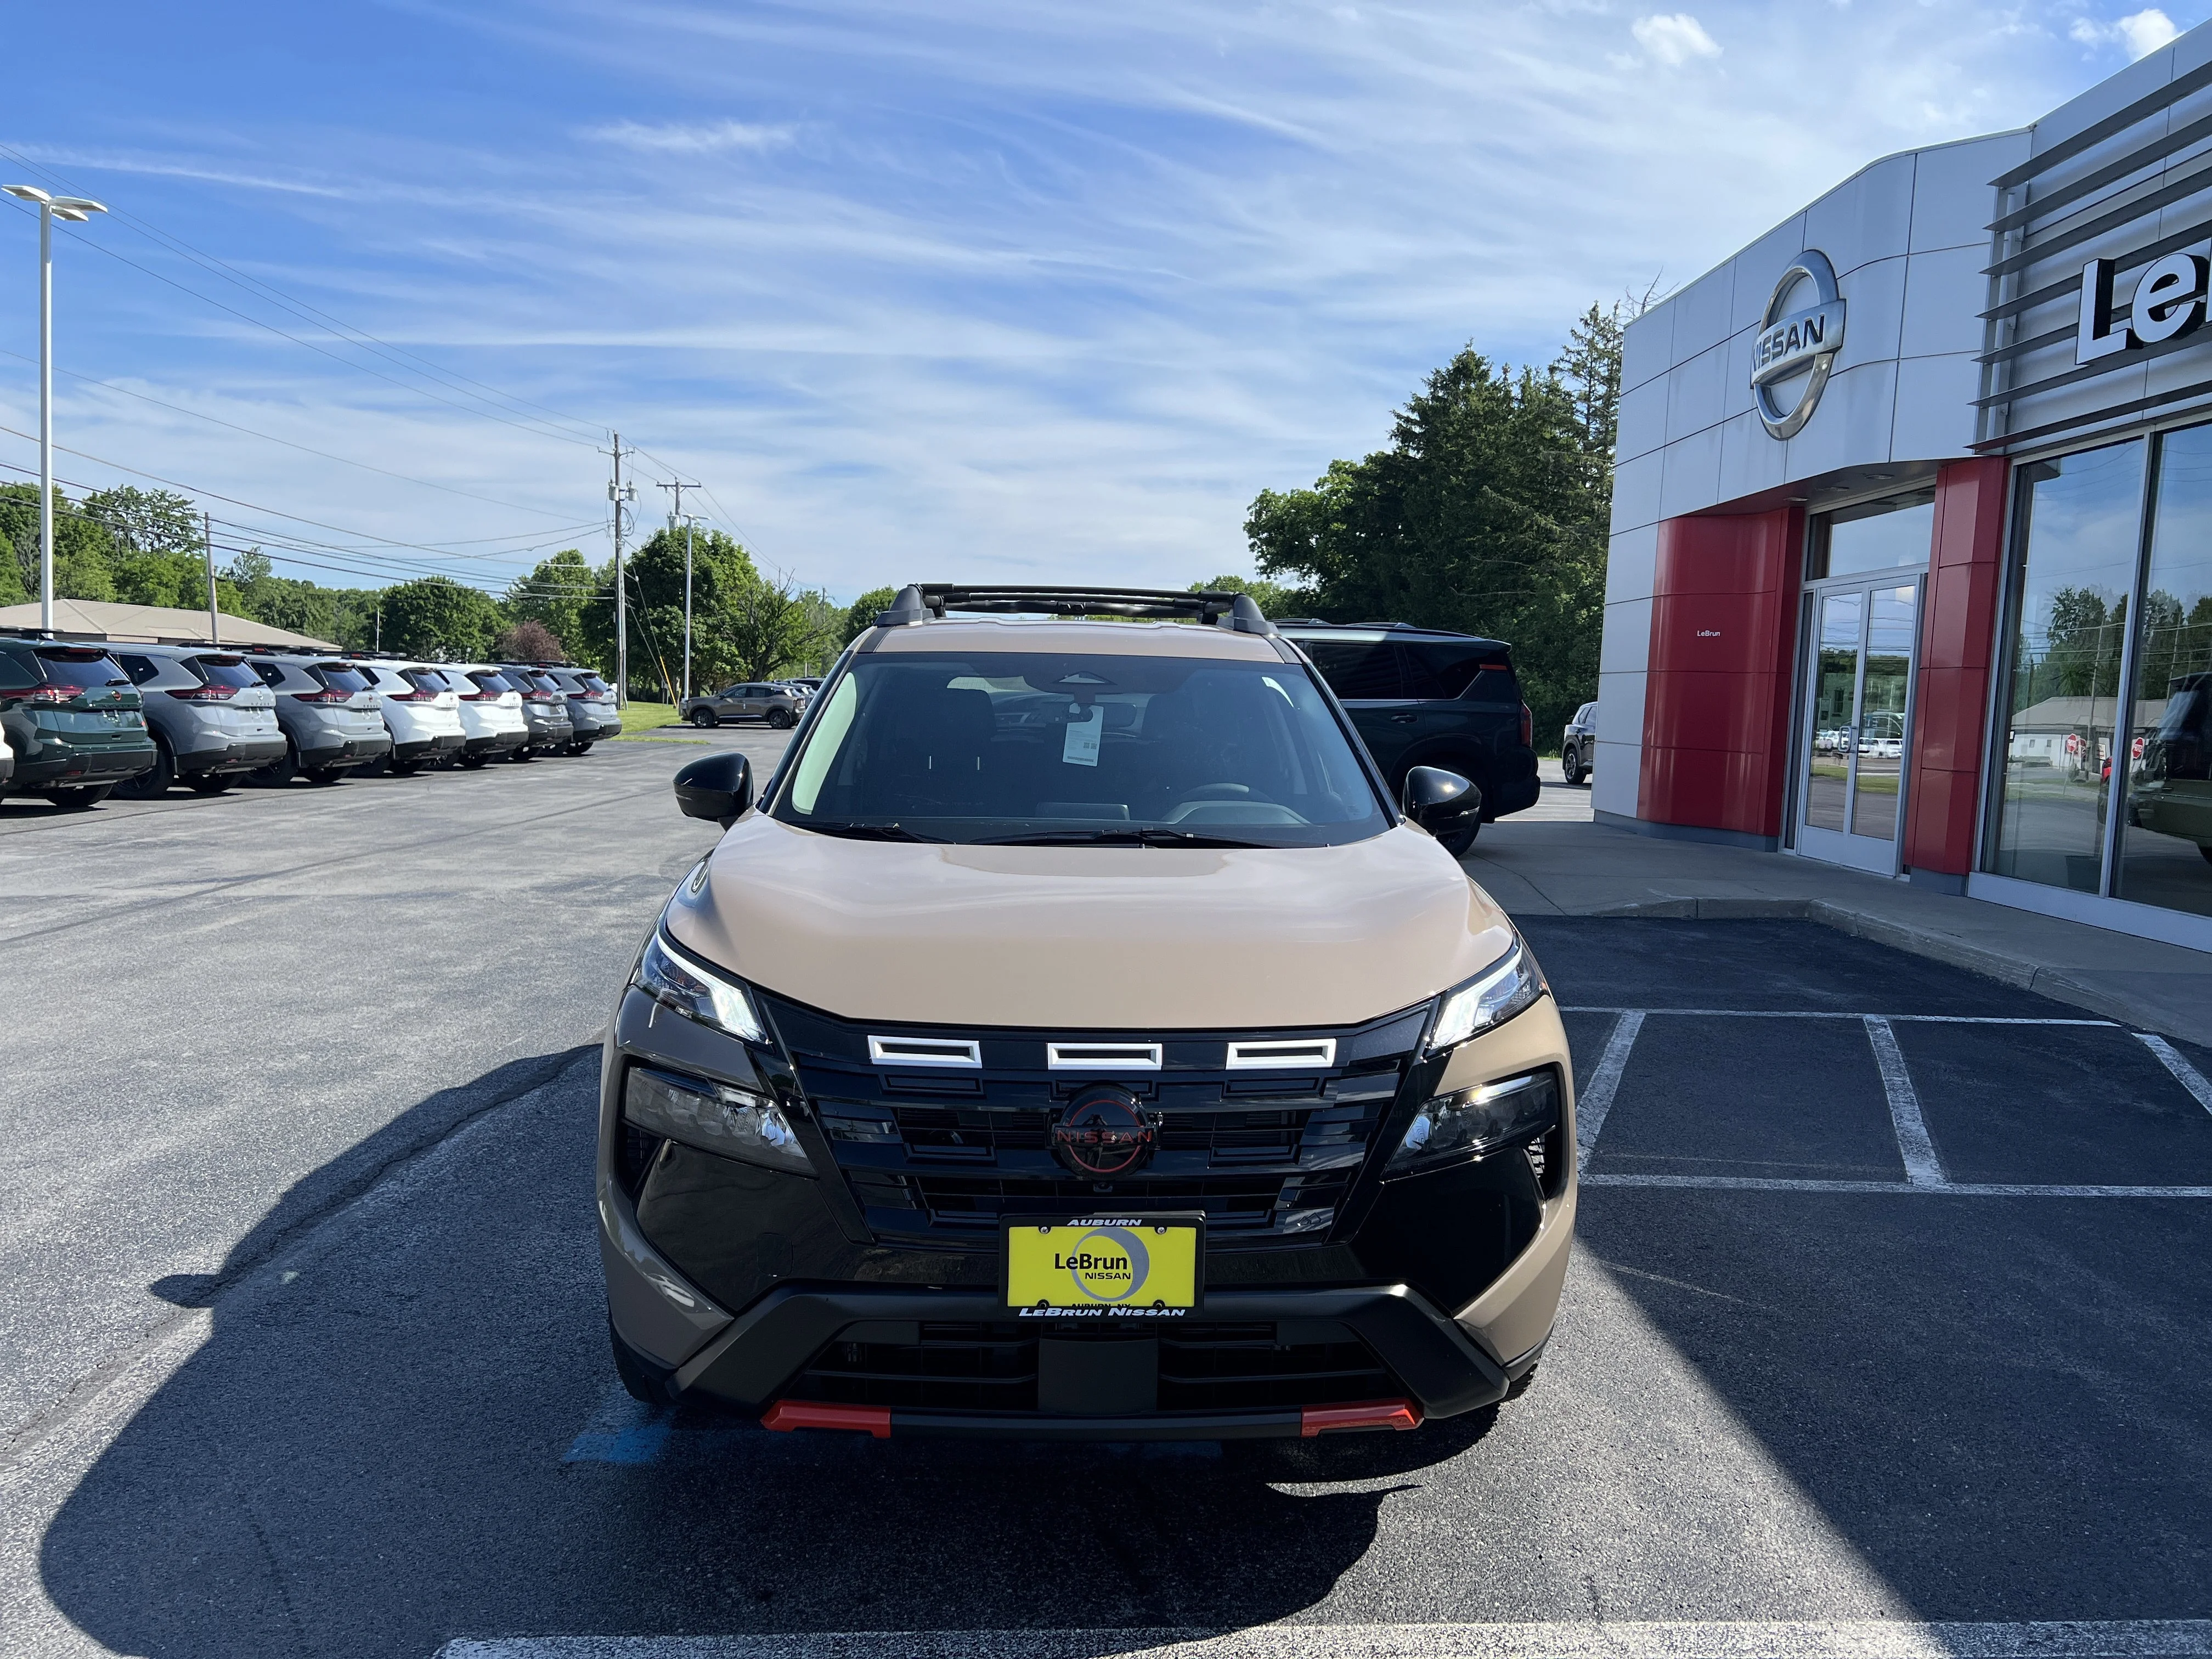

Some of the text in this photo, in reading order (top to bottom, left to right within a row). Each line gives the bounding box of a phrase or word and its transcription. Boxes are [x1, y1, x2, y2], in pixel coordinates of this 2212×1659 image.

[2075, 238, 2212, 365] Le
[1752, 313, 1825, 372] NISSAN
[1057, 1129, 1152, 1143] NISSAN
[1054, 1253, 1127, 1270] LeBrun
